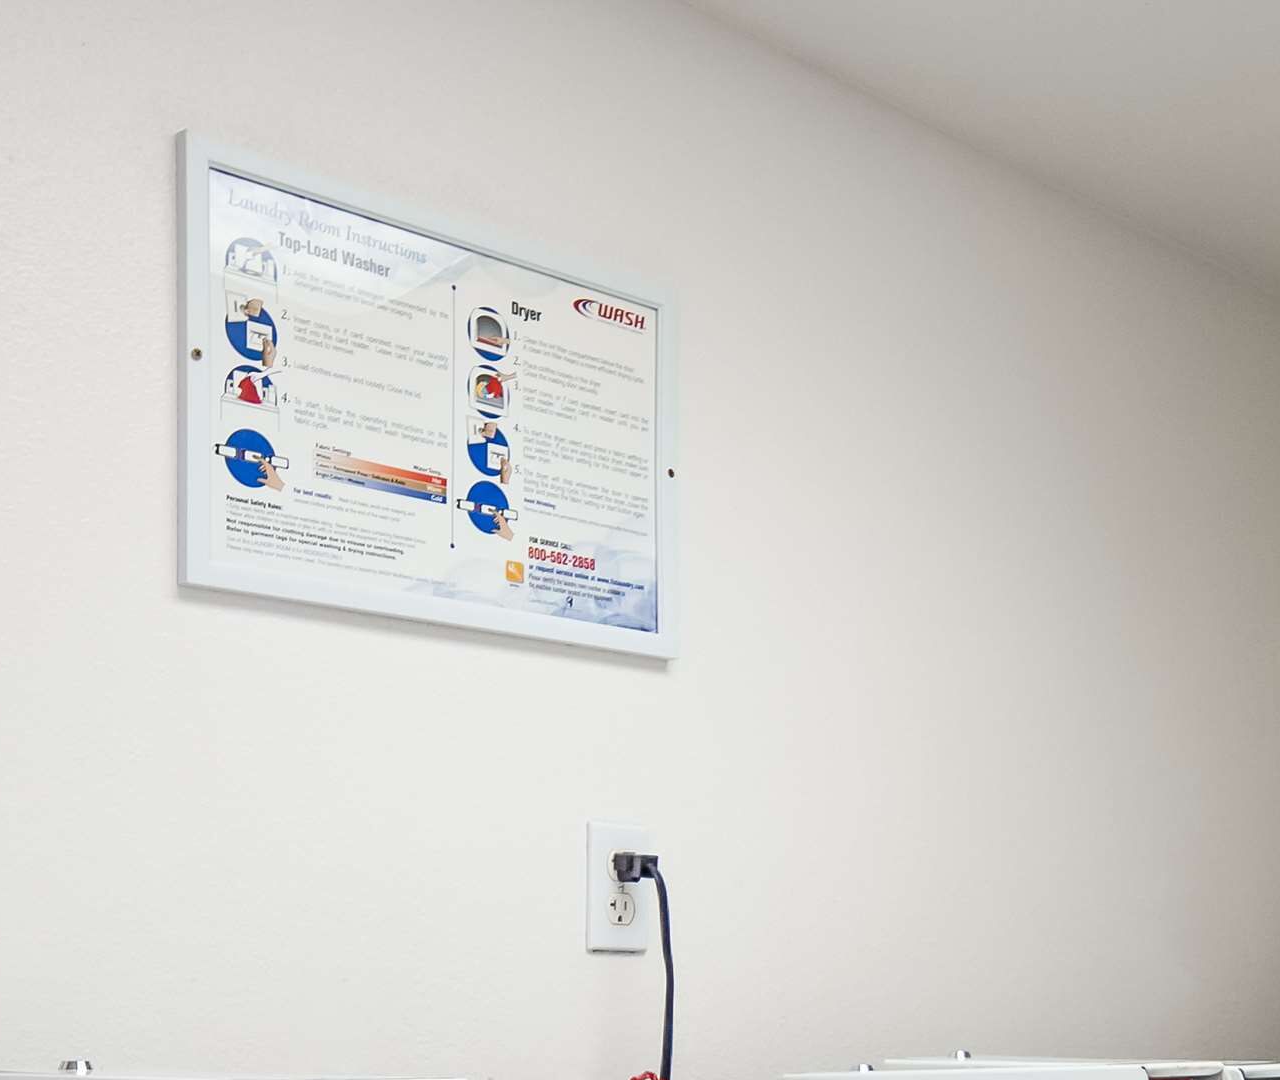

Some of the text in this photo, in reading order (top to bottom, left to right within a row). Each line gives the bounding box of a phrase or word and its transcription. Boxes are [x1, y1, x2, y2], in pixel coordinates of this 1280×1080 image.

[228, 188, 426, 265] Laundry Room Instructions
[279, 231, 390, 278] Top-Load Washer
[281, 309, 289, 320] 2.
[511, 301, 541, 325] Dryer
[598, 302, 644, 330] WASH
[281, 356, 291, 368] 3.
[281, 391, 290, 404] 4.
